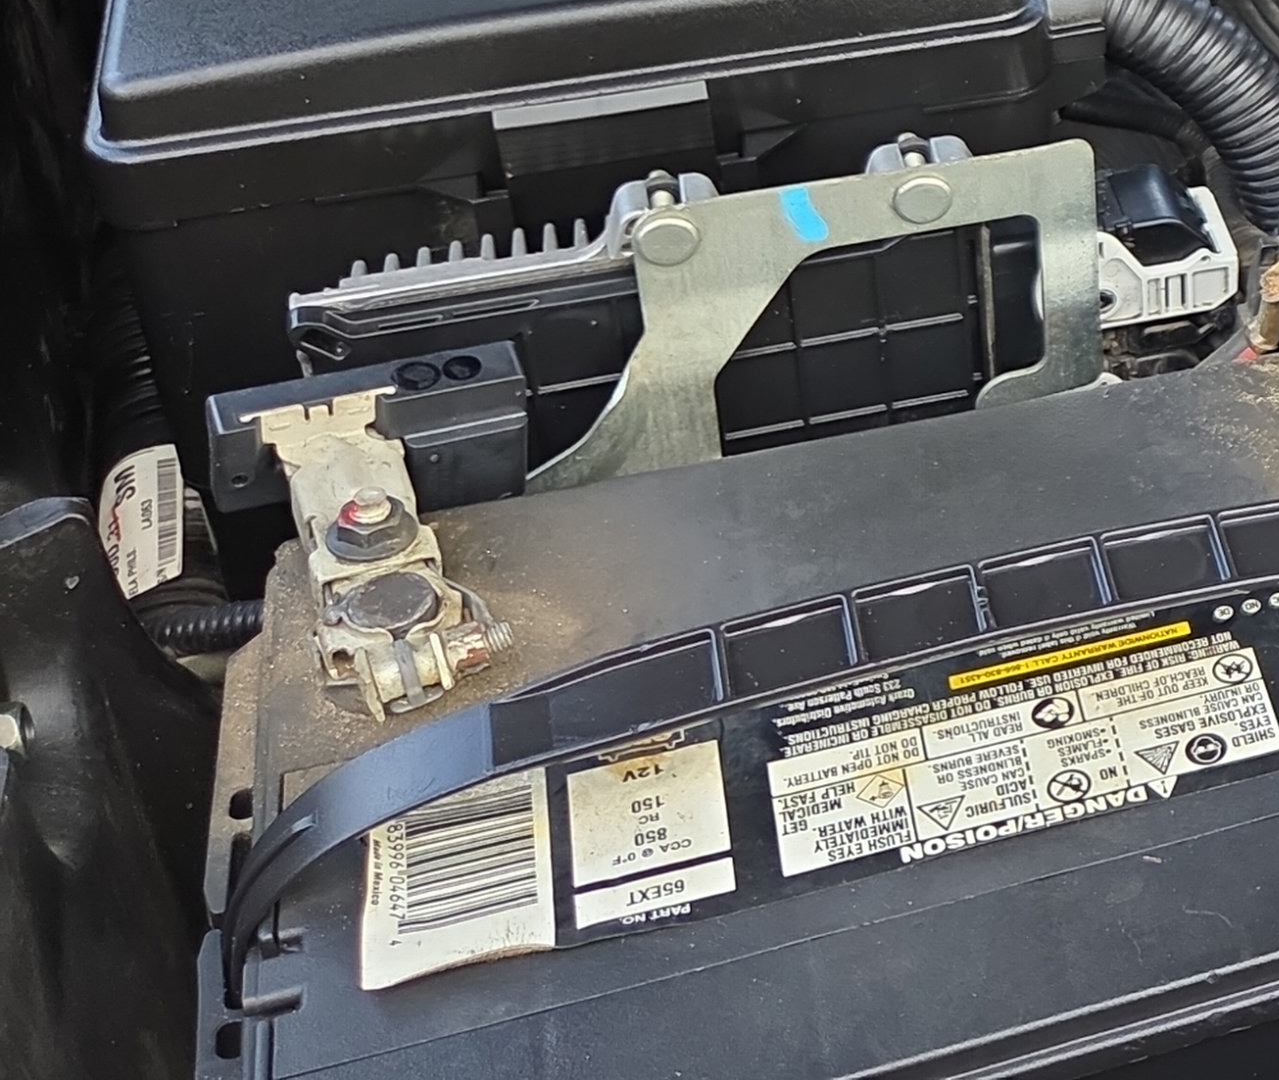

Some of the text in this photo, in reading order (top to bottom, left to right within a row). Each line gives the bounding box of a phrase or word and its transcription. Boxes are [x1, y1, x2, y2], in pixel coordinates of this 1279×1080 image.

[1116, 625, 1178, 647] NATIONWIDE
[1210, 630, 1231, 644] NOT
[1031, 653, 1058, 667] CALL
[1060, 640, 1115, 661] WARRANTY
[1128, 635, 1208, 664] RECOMMENDED
[1159, 652, 1186, 667] RISK
[1058, 661, 1104, 681] INVERTED
[1104, 655, 1128, 669] FOR
[1143, 658, 1159, 671] OF
[976, 679, 1024, 700] FOLLOW
[1036, 683, 1053, 696] OR
[1052, 669, 1114, 693] EXPLOSION
[1090, 678, 1150, 702] CHILDREN.
[1115, 675, 1209, 707] KEEP OUT OF THE
[1150, 674, 1167, 687] OF
[930, 691, 976, 710] PROPER
[1199, 681, 1260, 704] OR INJURY.
[870, 701, 930, 725] CHARGING
[948, 703, 972, 717] NOT
[973, 698, 991, 711] DO
[1138, 691, 1263, 730] CAN CAUSE BLINDNESS
[782, 716, 871, 746] INSTRUCTIONS.
[870, 708, 948, 736] DISASSEMBLE
[930, 709, 1020, 741] INSTRUCTIONS.
[967, 720, 1023, 742] READ ALL
[1153, 701, 1267, 739] EXPLOSIVE GASES
[1233, 714, 1271, 732] EYES.
[778, 732, 850, 757] INCINERATE.
[850, 727, 869, 741] OR
[1230, 726, 1276, 747] SHIELD
[848, 735, 917, 760] DO NOT TIP.
[782, 746, 919, 788] DO NOT OPEN BATTERY.
[926, 743, 1019, 775] SEVERE BURNS.
[935, 754, 1022, 784] BLINDNESS OR
[620, 762, 664, 782] 12V
[959, 766, 1025, 791] CAN CAUSE
[1098, 765, 1118, 780] NO
[776, 780, 856, 809] HELP FAST.
[994, 778, 1028, 795] ACID
[629, 794, 665, 813] 150
[777, 797, 842, 822] MEDICAL
[963, 791, 1032, 818] SULFURIC
[636, 811, 660, 825] RC
[779, 818, 808, 836] GET
[811, 805, 906, 838] WITH WATER.
[896, 783, 1150, 863] DANGER/POISON
[632, 826, 668, 846] 850
[658, 837, 692, 853] CCA
[811, 818, 910, 852] IMMEDIATELY
[826, 831, 912, 861] FLUSH EYES
[372, 839, 382, 861] Made
[371, 872, 384, 906] Mexico
[388, 876, 406, 920] 04647
[623, 878, 686, 905] 65EXT
[618, 903, 691, 925] PART NO.
